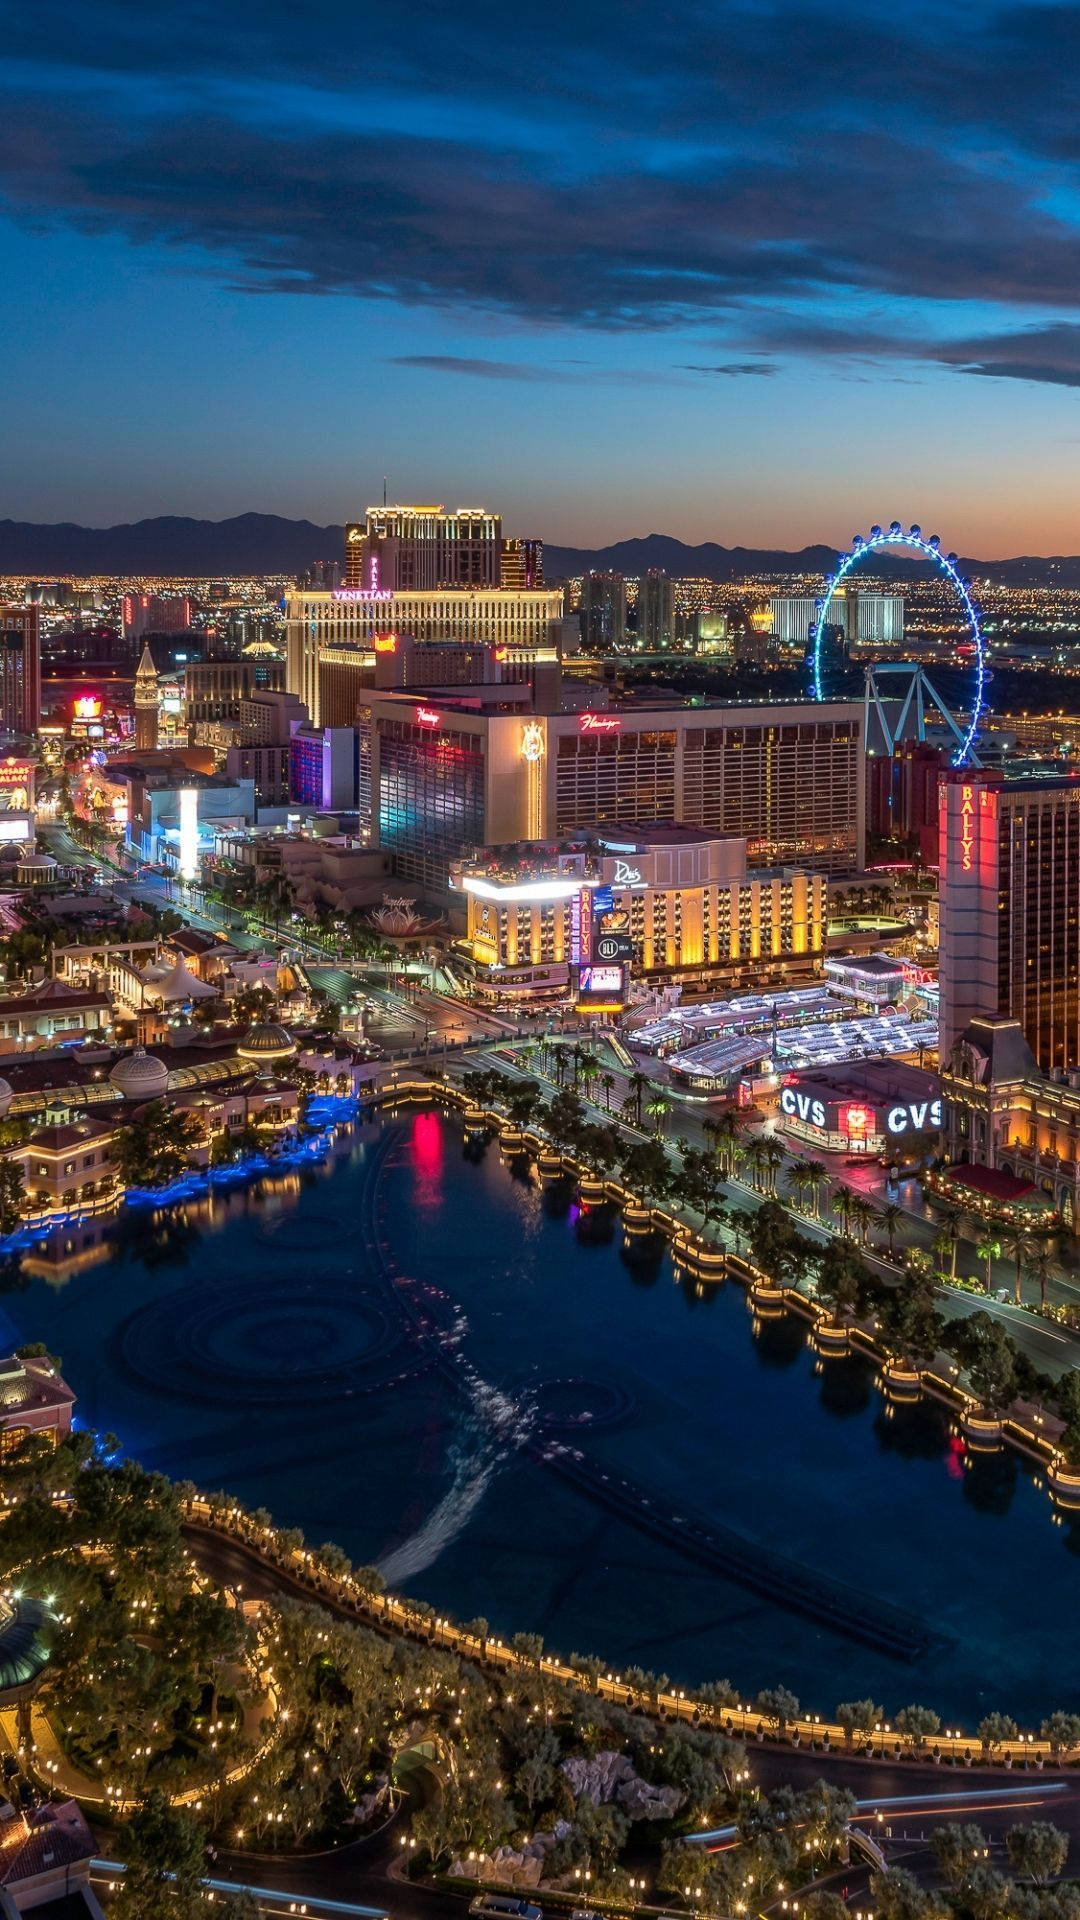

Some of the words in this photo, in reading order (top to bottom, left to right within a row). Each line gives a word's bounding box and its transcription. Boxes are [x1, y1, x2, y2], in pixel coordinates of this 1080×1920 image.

[333, 590, 392, 600] VENETIAN
[602, 942, 614, 954] BLT
[781, 1088, 825, 1127] CVS
[887, 1100, 942, 1133] CVS
